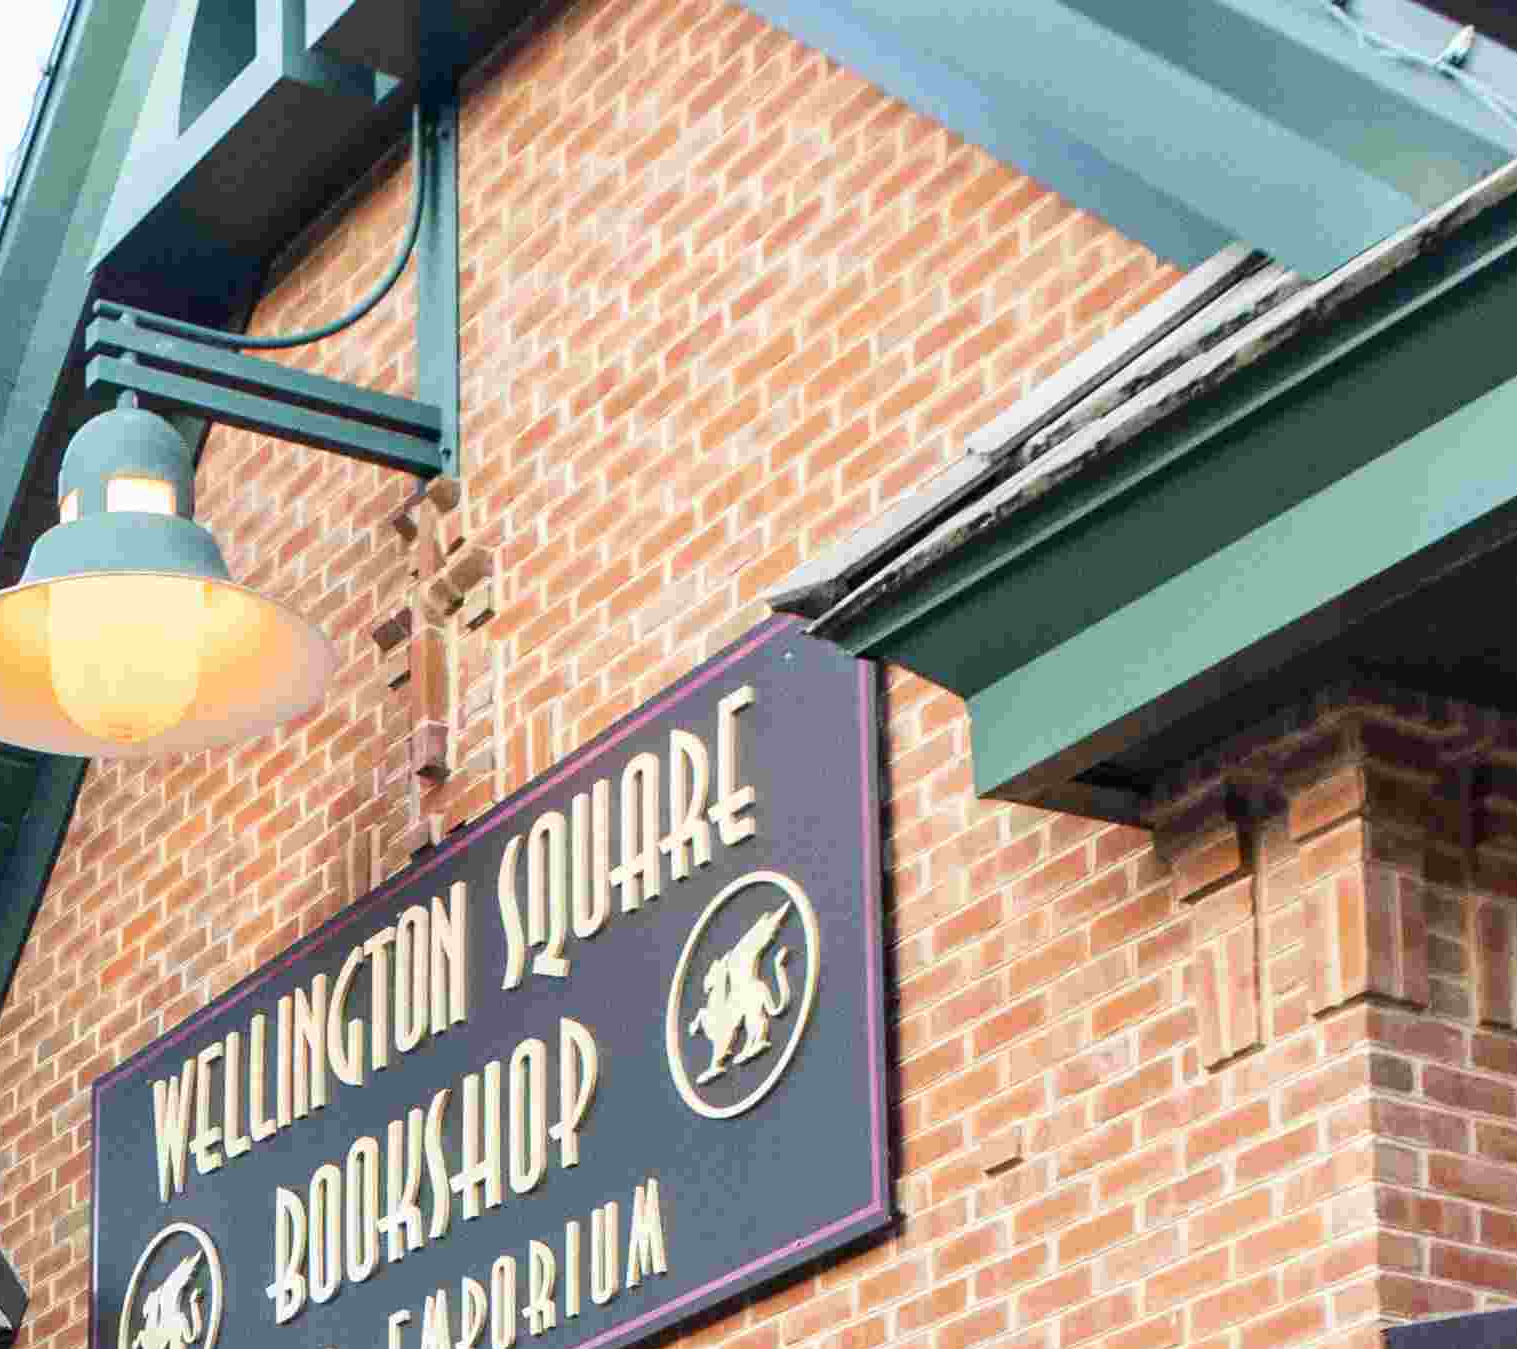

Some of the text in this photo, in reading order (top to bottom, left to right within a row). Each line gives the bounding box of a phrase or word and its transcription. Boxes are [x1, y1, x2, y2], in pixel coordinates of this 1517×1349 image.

[151, 685, 756, 1203] WELLINGTON SQUARE
[266, 1018, 600, 1326] BOOKSHOP
